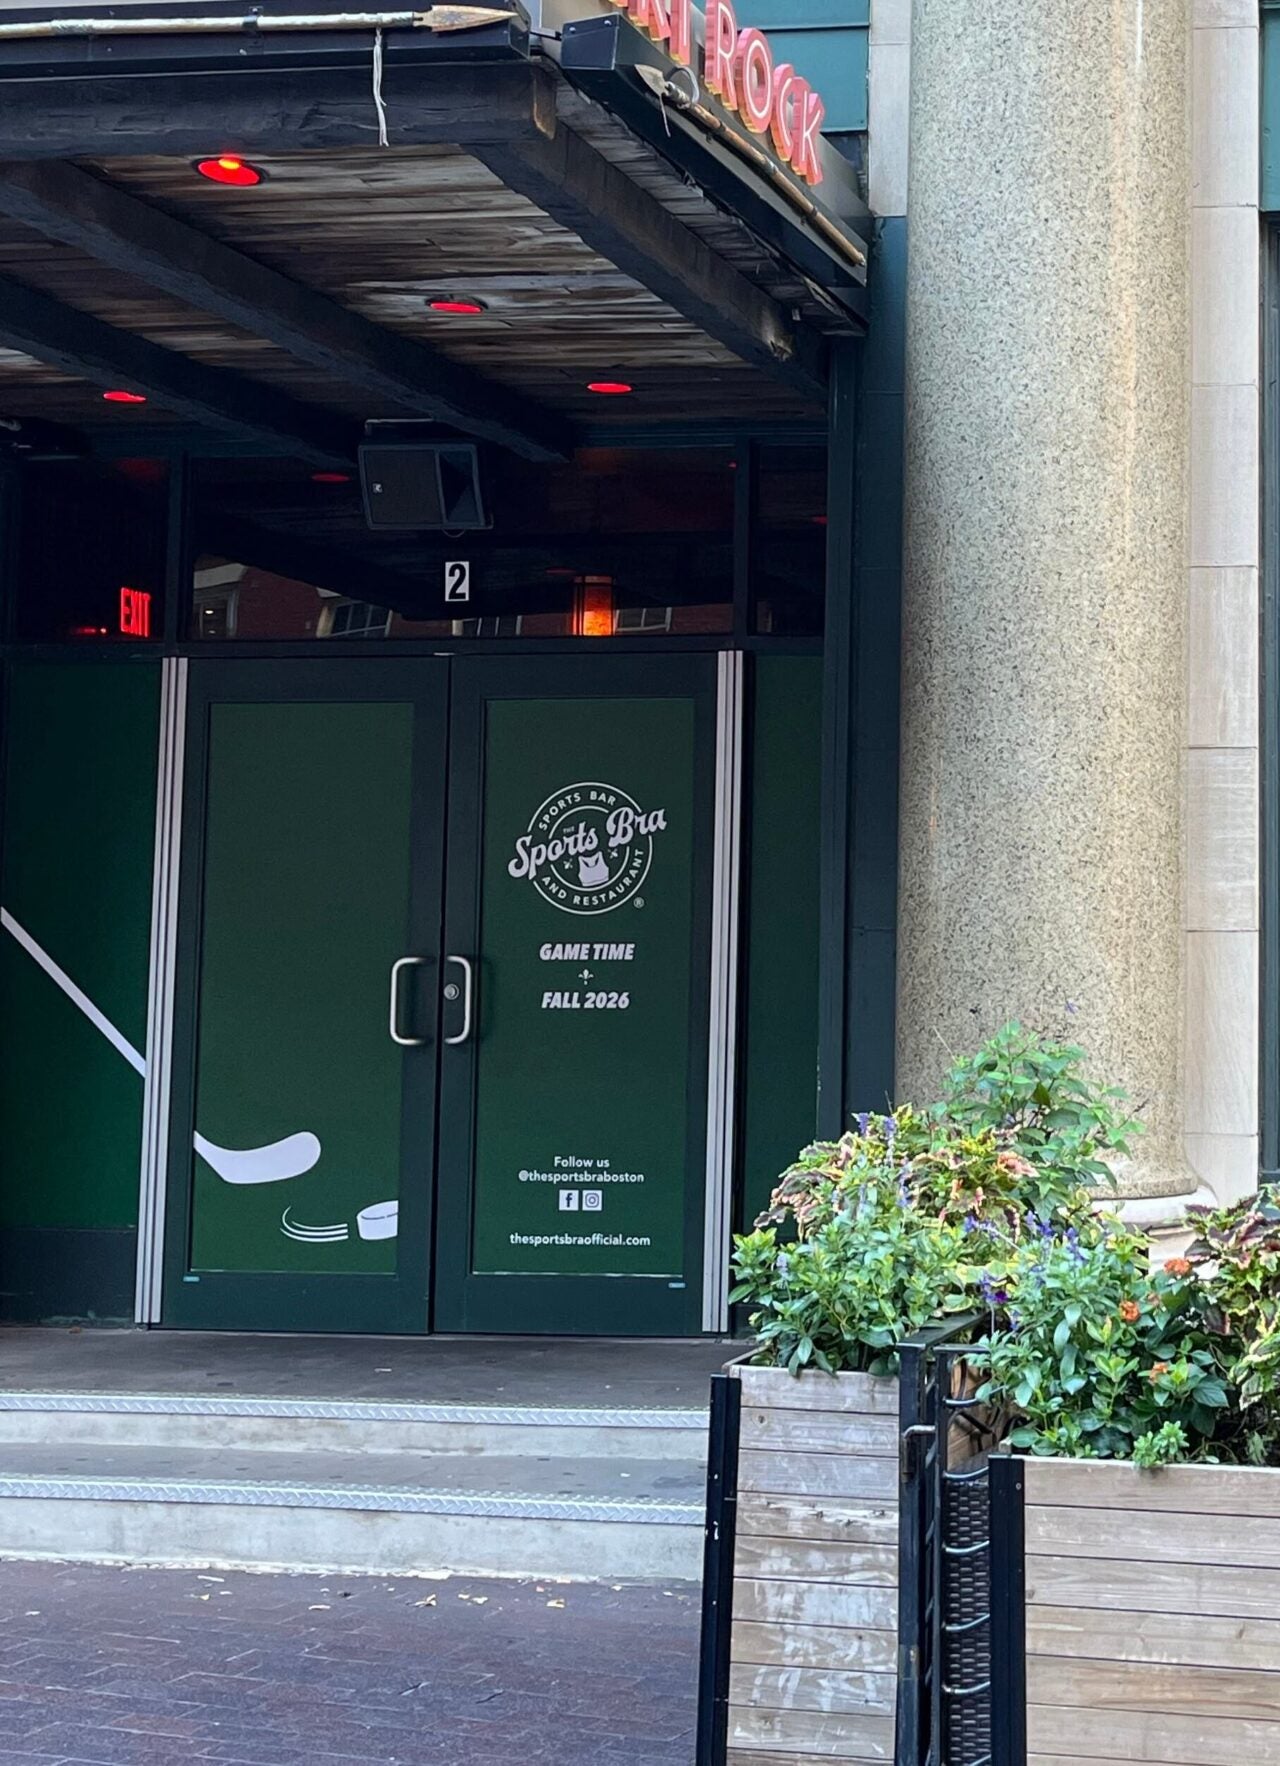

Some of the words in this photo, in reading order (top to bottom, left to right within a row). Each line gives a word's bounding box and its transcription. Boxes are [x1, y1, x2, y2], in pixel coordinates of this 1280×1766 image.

[704, 0, 825, 185] ROCK
[448, 563, 467, 600] 2
[120, 586, 151, 638] EXIT
[538, 792, 581, 831] SPORTS
[590, 791, 617, 806] BAR
[508, 821, 598, 880] Sports
[606, 806, 667, 848] Bra
[541, 876, 567, 899] AND
[572, 849, 644, 905] RESTAURANT
[539, 943, 593, 961] GAME
[594, 943, 635, 961] TIME
[541, 992, 580, 1009] FALL
[585, 992, 630, 1009] 2026
[518, 1169, 644, 1184] @thesportsbraboston
[553, 1155, 593, 1168] Follow
[596, 1159, 610, 1168] us
[510, 1232, 651, 1247] thesportsbraofficial.com
